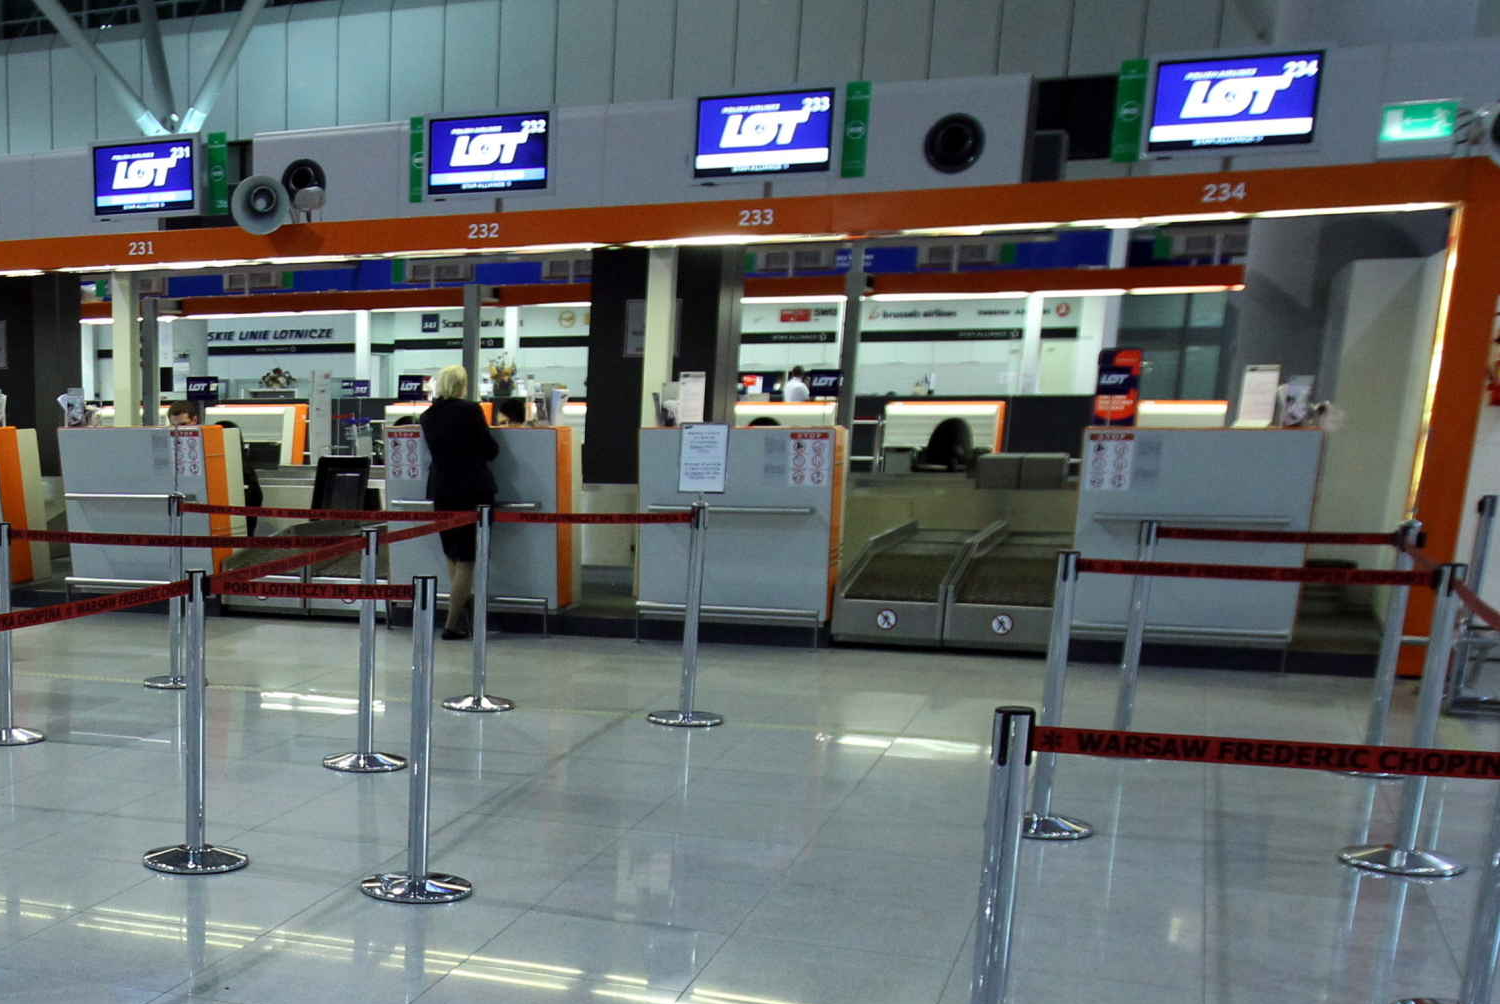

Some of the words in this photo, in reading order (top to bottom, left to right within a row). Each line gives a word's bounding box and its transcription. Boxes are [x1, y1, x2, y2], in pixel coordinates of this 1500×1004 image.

[1184, 71, 1217, 81] POLISH
[1218, 68, 1258, 78] AIRLINES
[1283, 60, 1318, 78] 234
[801, 96, 830, 112] 233
[1179, 74, 1294, 119] LOT
[721, 105, 748, 114] POLISH
[748, 103, 781, 113] AIRLINES
[520, 119, 546, 134] 232
[719, 109, 811, 148] LOT
[169, 146, 190, 159] 231
[449, 132, 529, 167] LOT
[111, 156, 177, 190] LOT
[1202, 183, 1247, 203] 234
[738, 208, 774, 226] 233
[468, 223, 499, 239] 232
[128, 241, 154, 256] 231
[882, 308, 920, 319] brussels
[923, 308, 958, 318] airlines
[207, 331, 235, 342] SKIE
[238, 329, 270, 341] LINIE
[273, 328, 334, 340] LOTNICZE
[812, 376, 838, 386] LOT
[1100, 373, 1130, 384] LOT
[188, 383, 208, 391] LOT
[400, 382, 421, 391] LOT
[236, 506, 273, 516] CHOPINA
[287, 508, 326, 518] WARSAW
[329, 509, 374, 519] FREDERIC
[375, 510, 412, 521] CHOPIN
[413, 511, 454, 521] AIRPORT
[520, 513, 550, 522] PORT
[550, 513, 597, 523] LOTNICZY
[619, 513, 680, 523] FRYDERYKA
[27, 531, 83, 544] FRYDERYKA
[85, 533, 131, 545] CHOPINA
[147, 536, 192, 547] WARSAW
[194, 537, 247, 548] FREDERIC
[250, 537, 293, 548] CHOPIN
[294, 537, 343, 548] AIRPORT
[1122, 562, 1190, 576] WARSAW
[224, 581, 259, 594] PORT
[261, 582, 326, 596] LOTNICZY
[331, 584, 353, 597] IM.
[358, 585, 416, 598] FRYDER
[18, 606, 62, 627] CHOPINA
[76, 597, 117, 615] WARSAW
[119, 588, 161, 608] FREDERIC
[1077, 732, 1209, 760] WARSAW
[1218, 741, 1372, 770] FREDERIC
